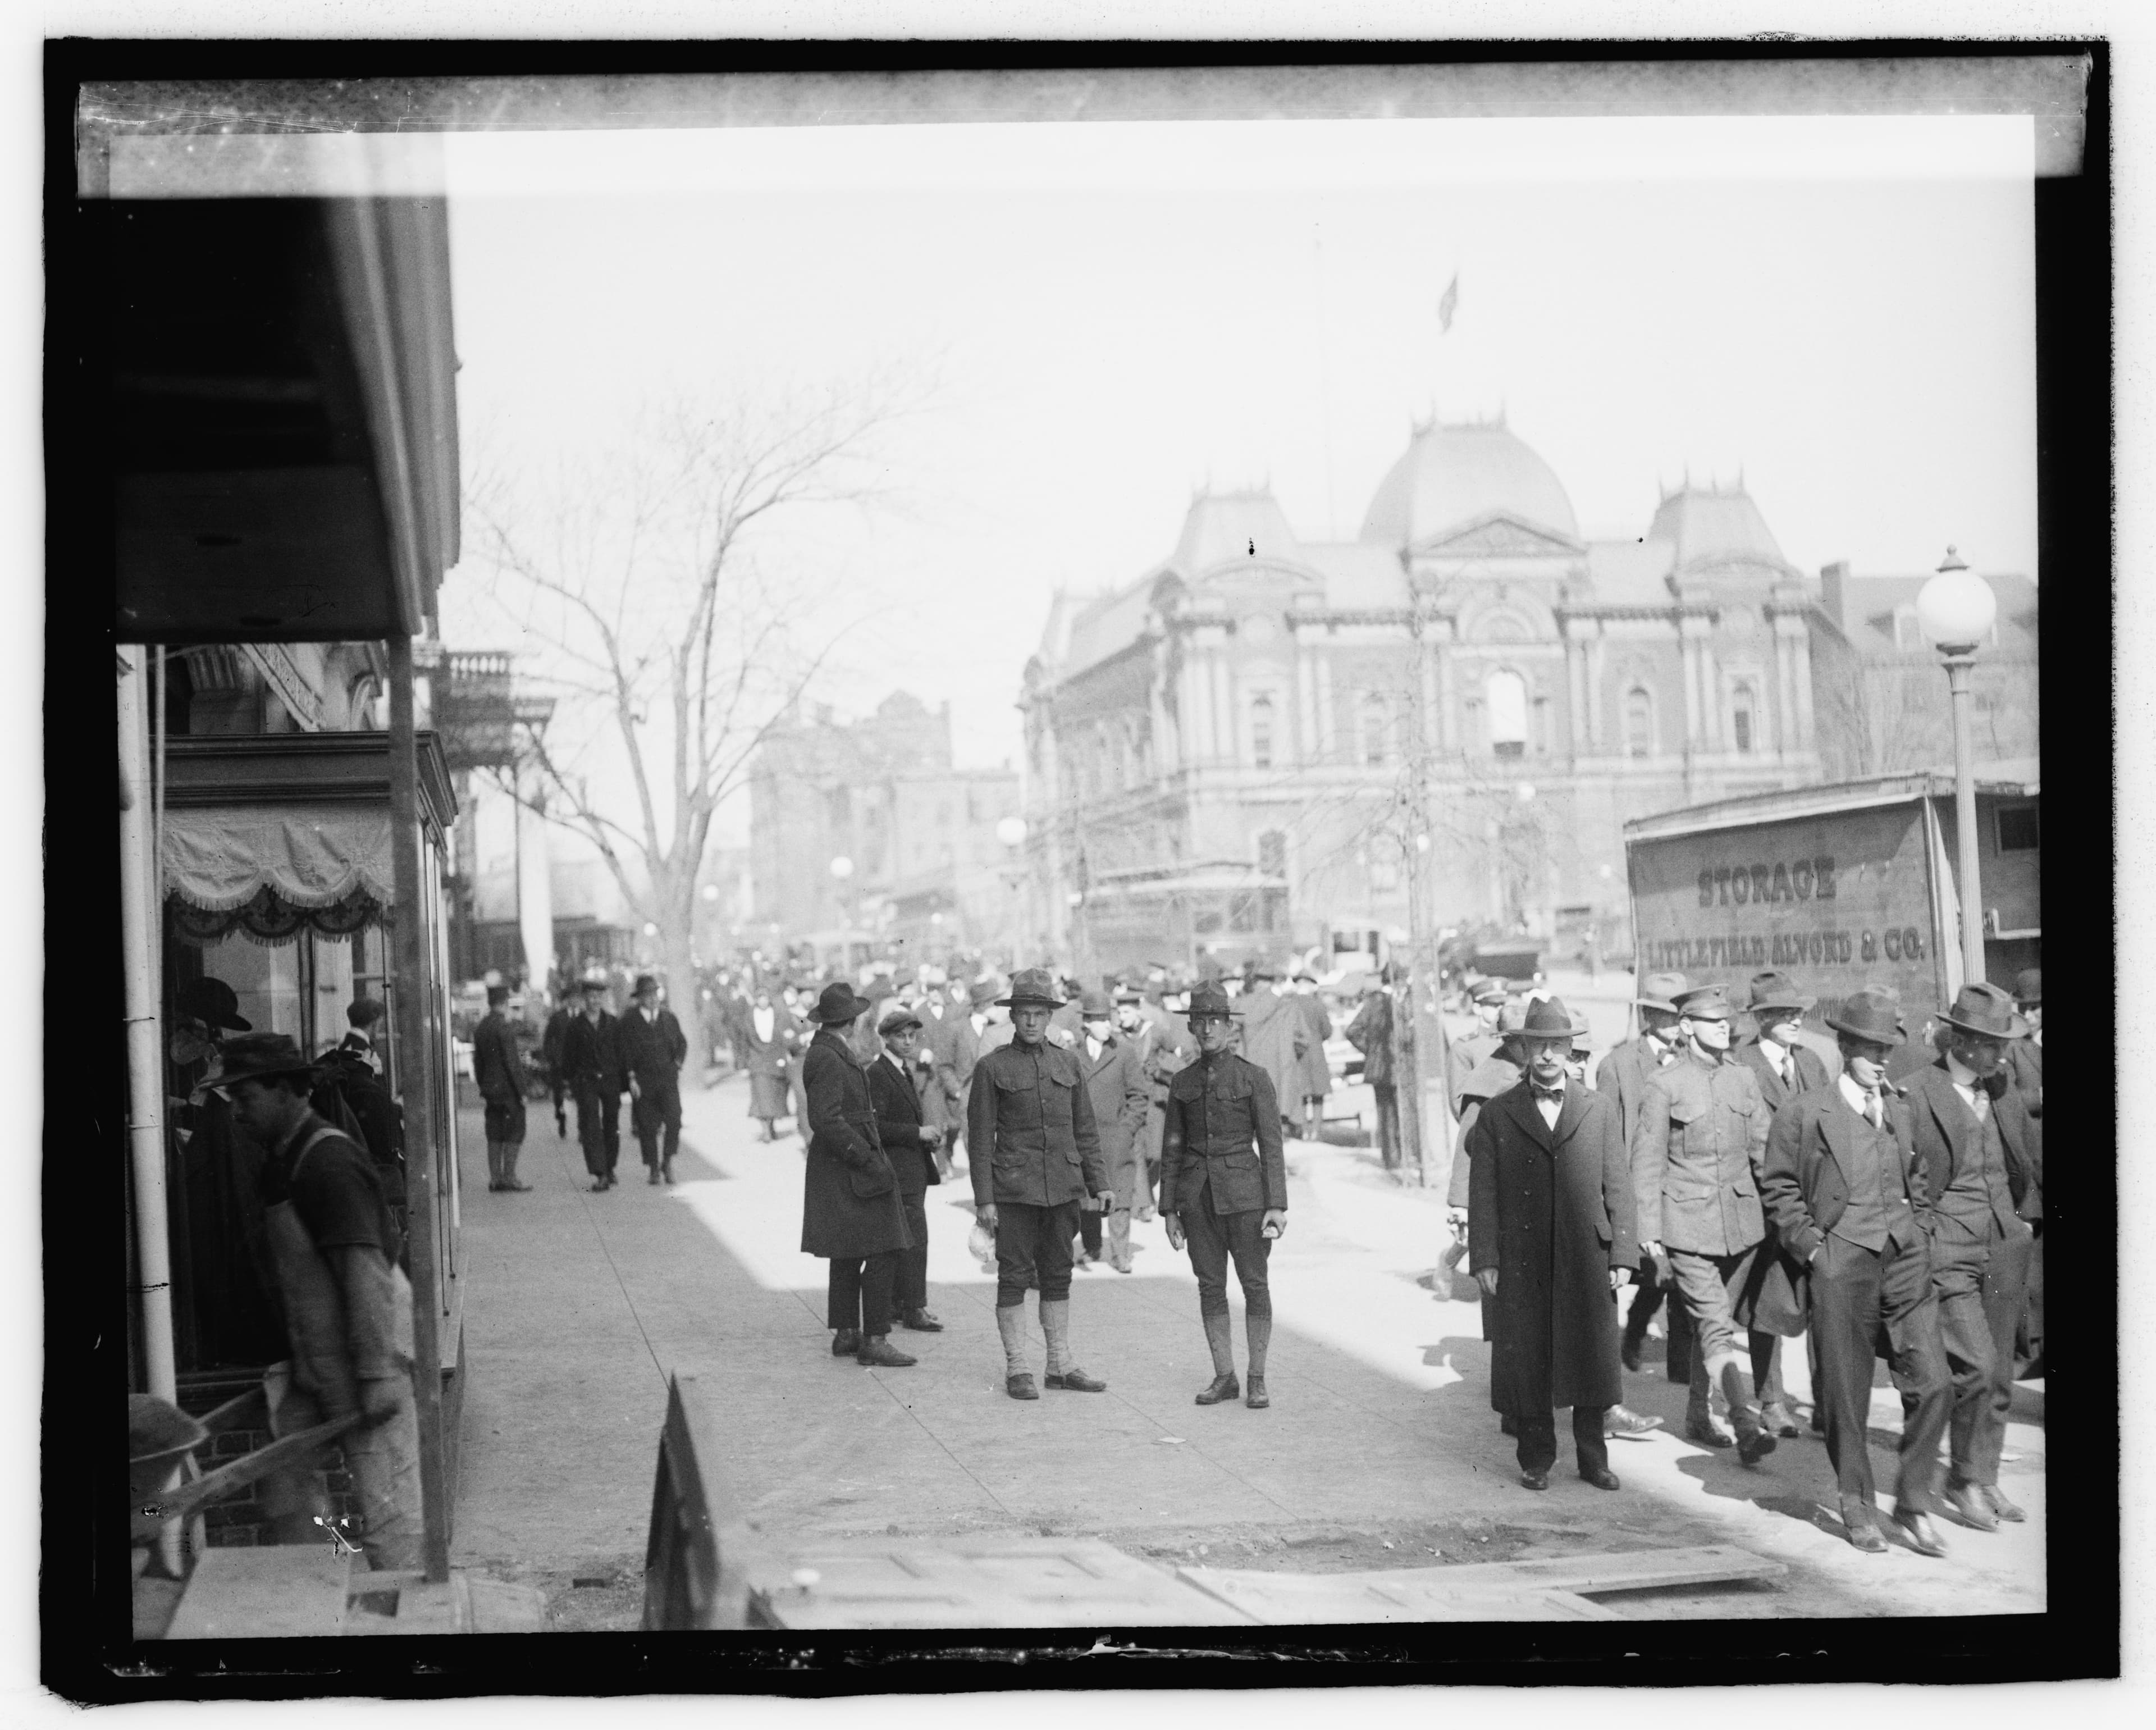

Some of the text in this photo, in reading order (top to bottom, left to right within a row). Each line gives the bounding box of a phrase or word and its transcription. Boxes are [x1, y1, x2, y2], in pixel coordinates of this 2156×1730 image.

[1698, 857, 1837, 907] STORAGE
[1771, 931, 1852, 965] ALVORD
[1861, 930, 1877, 962] &
[1884, 927, 1926, 961] CO.
